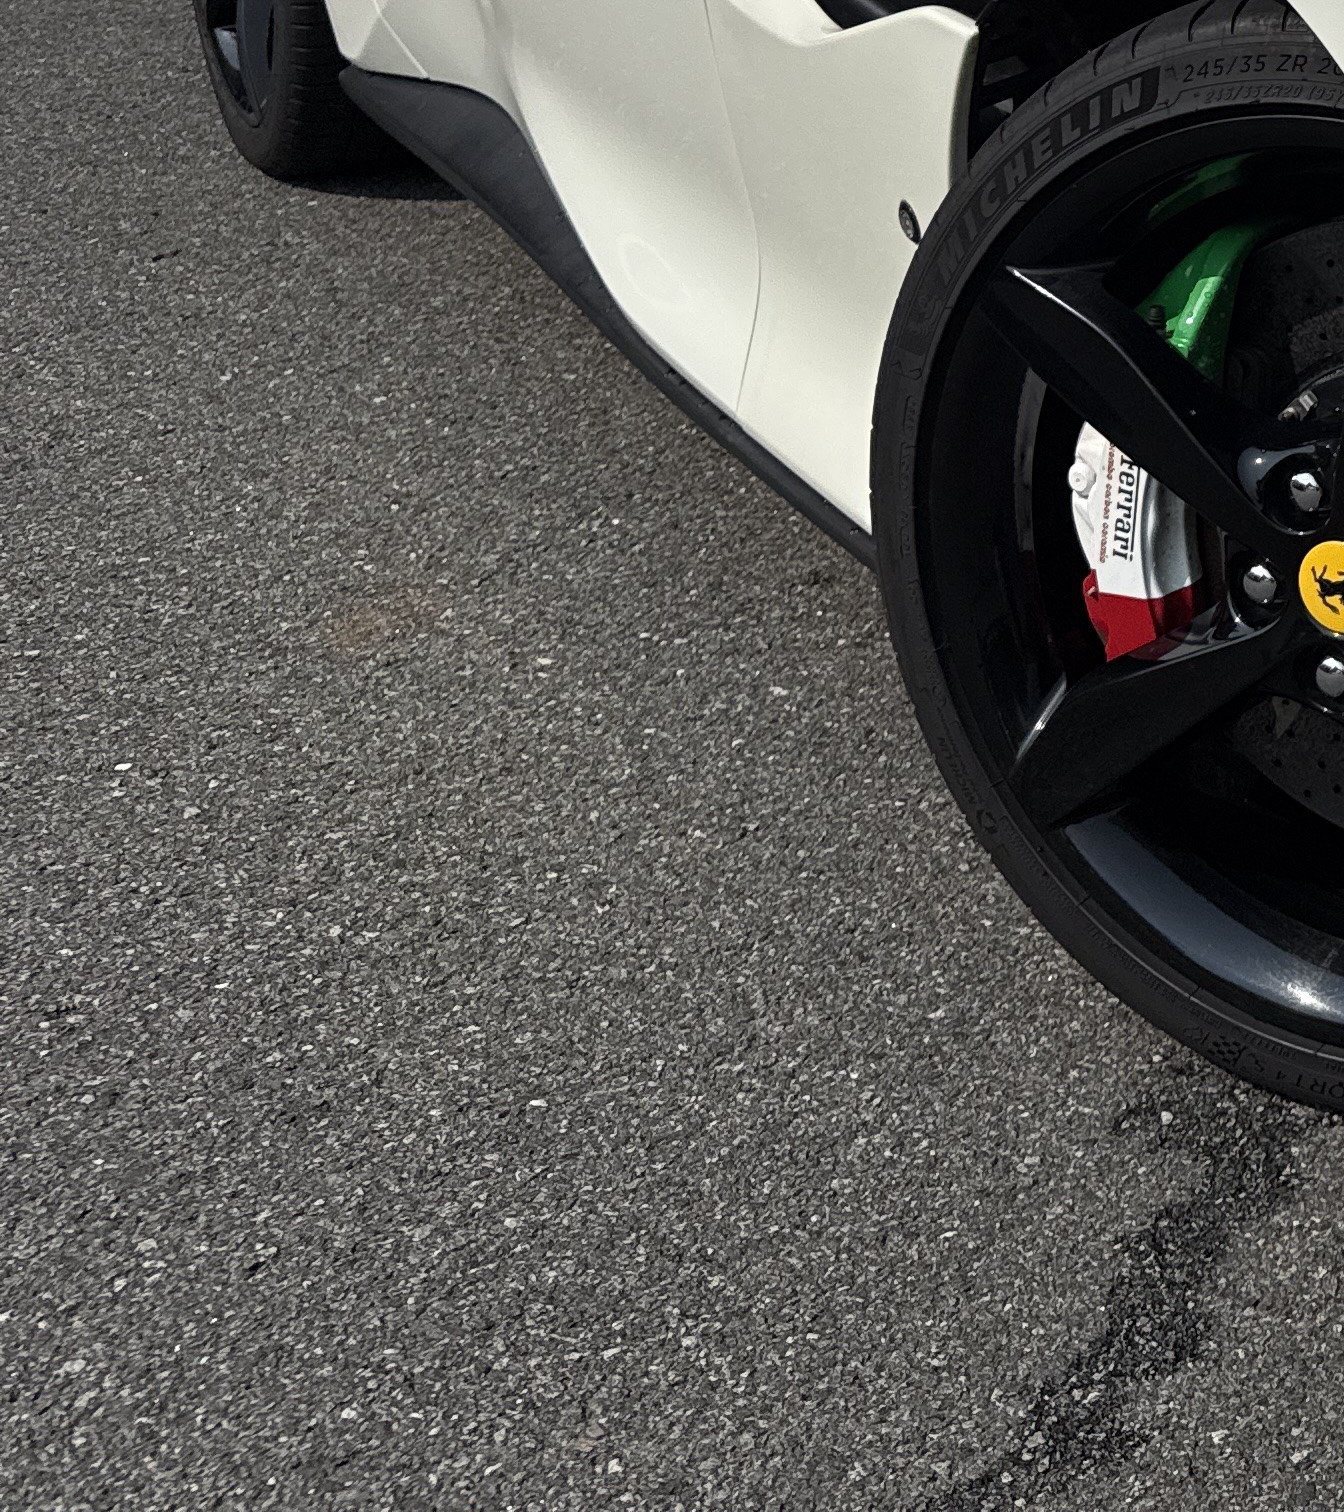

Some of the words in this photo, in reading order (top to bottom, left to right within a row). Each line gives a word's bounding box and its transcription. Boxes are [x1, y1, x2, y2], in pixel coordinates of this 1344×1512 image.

[1183, 55, 1266, 83] 245/35
[1276, 54, 1308, 72] ZR
[936, 76, 1143, 286] MICHELIN
